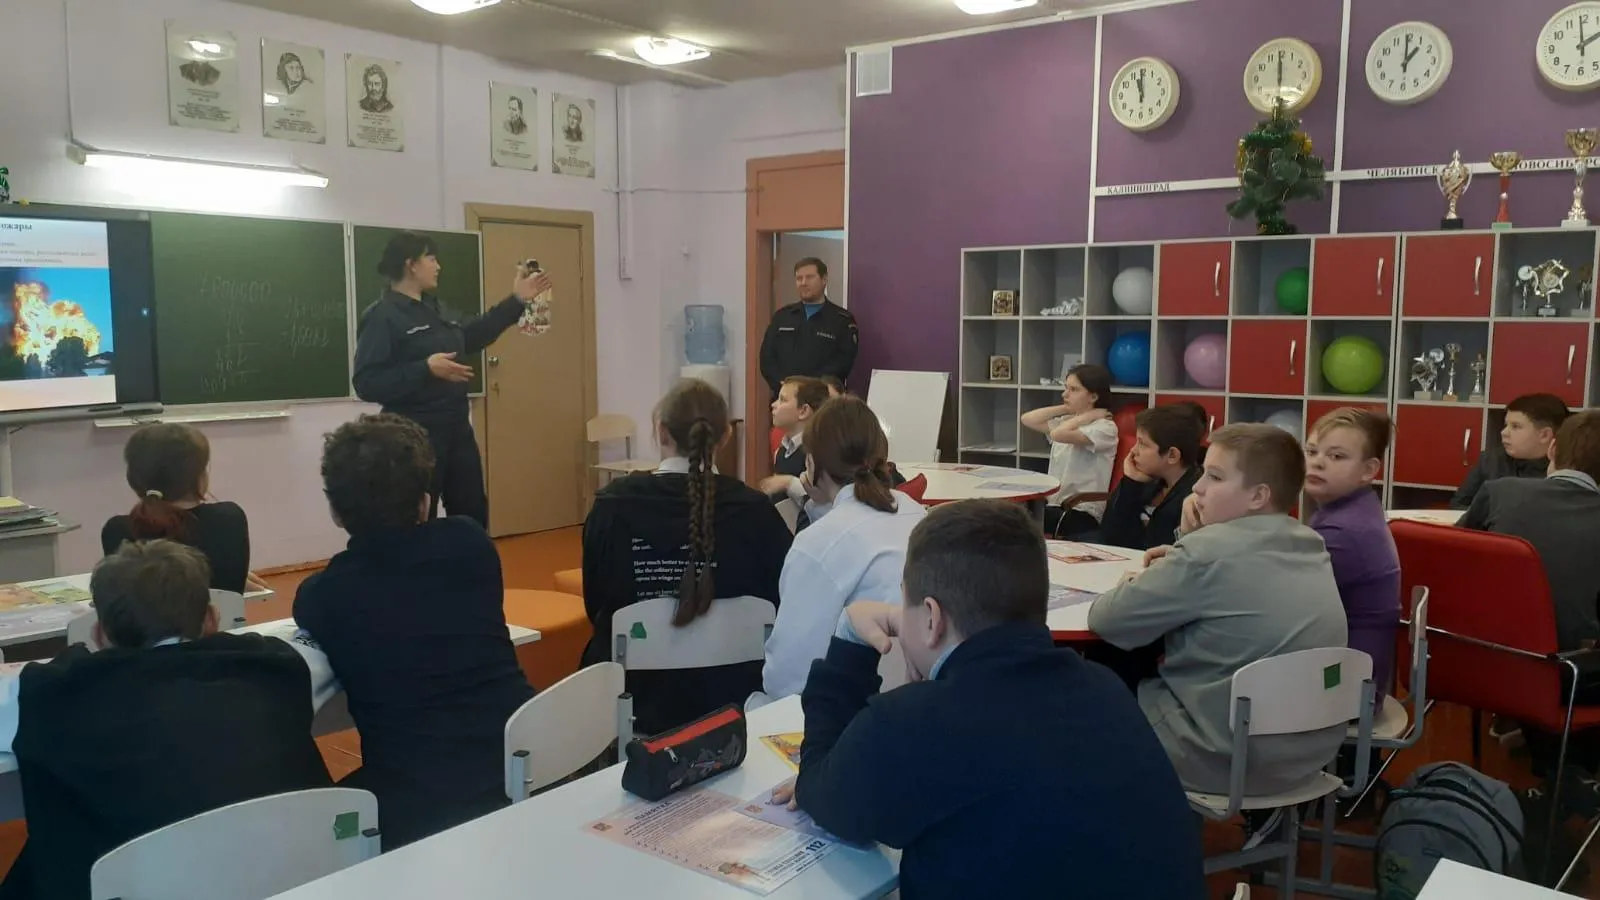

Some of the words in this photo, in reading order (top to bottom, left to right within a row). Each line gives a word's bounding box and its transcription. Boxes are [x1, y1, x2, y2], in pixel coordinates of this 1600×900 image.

[1566, 20, 1573, 30] 11
[1553, 30, 1564, 40] 10
[1393, 37, 1400, 47] 11
[1382, 47, 1391, 56] 10
[1426, 44, 1432, 54] 2
[1548, 44, 1555, 54] 9
[1267, 54, 1274, 62] 11
[1553, 56, 1560, 65] 8
[1258, 63, 1266, 72] 10
[1376, 59, 1382, 68] 9
[1592, 61, 1599, 71] 5
[1424, 69, 1430, 78] 4
[1564, 64, 1570, 74] 7
[1577, 66, 1584, 76] 6
[1130, 72, 1136, 80] 11
[1380, 71, 1386, 80] 8
[1122, 81, 1129, 89] 10
[1387, 80, 1394, 88] 7
[1400, 82, 1406, 91] 6
[1413, 78, 1419, 87] 5
[1118, 92, 1124, 100] 9
[1107, 183, 1170, 194] КАЛИНИНГРАД
[0, 222, 33, 232] ожары
[805, 840, 826, 852] 112
